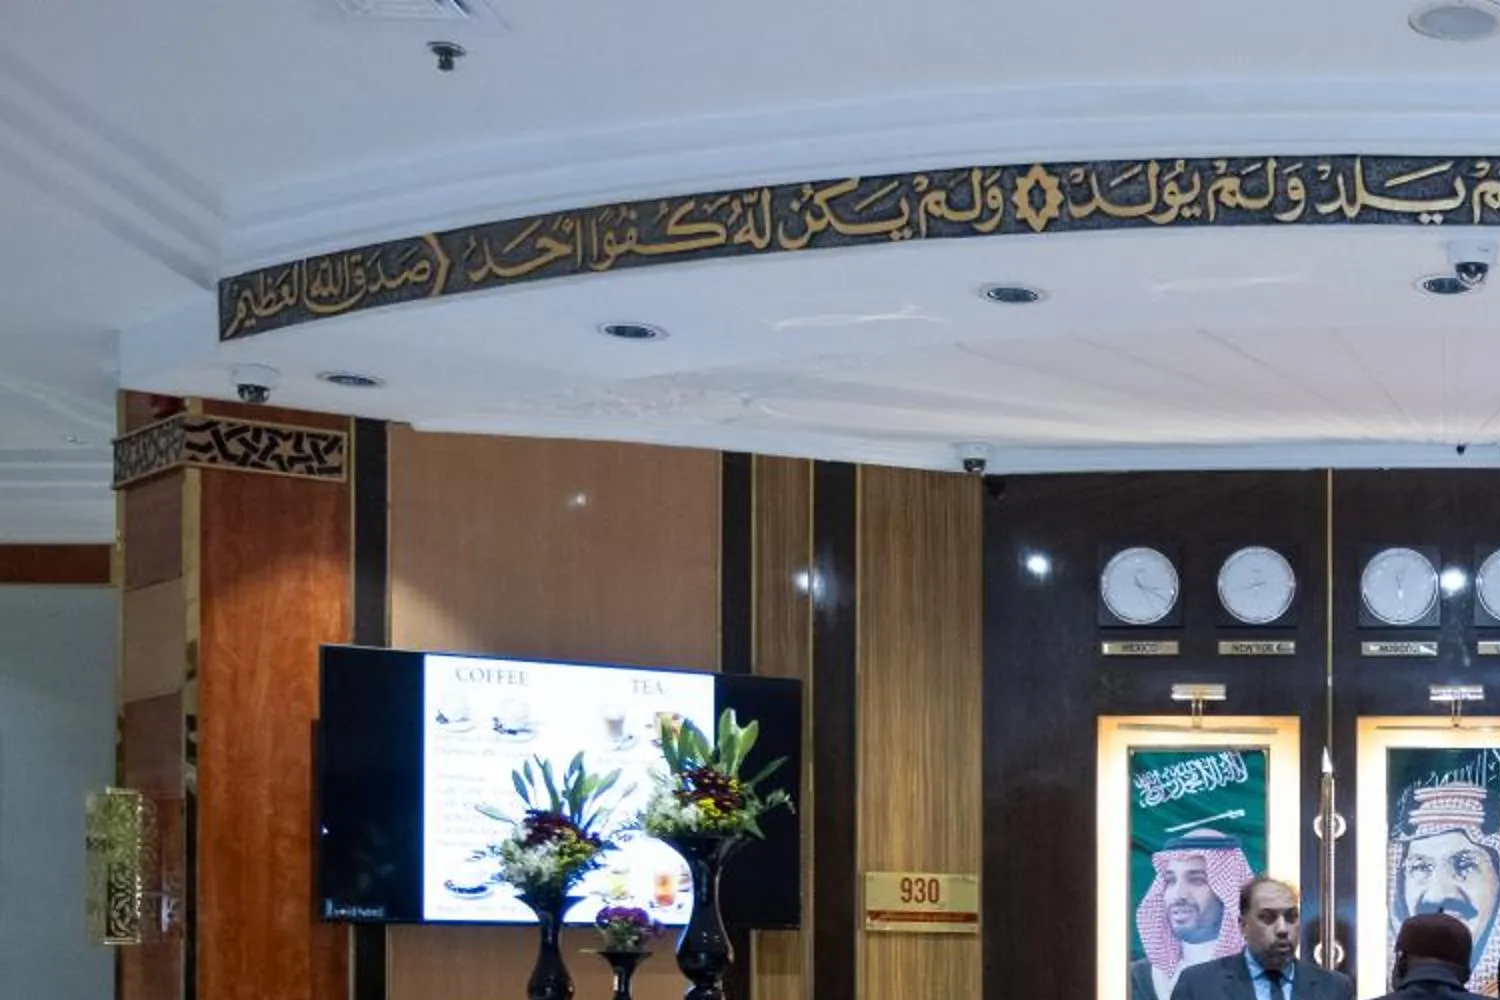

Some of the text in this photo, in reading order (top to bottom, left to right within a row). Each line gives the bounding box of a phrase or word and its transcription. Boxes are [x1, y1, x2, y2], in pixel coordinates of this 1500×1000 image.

[455, 666, 531, 687] COFFEE
[631, 678, 665, 696] TEA
[899, 876, 940, 904] 930
